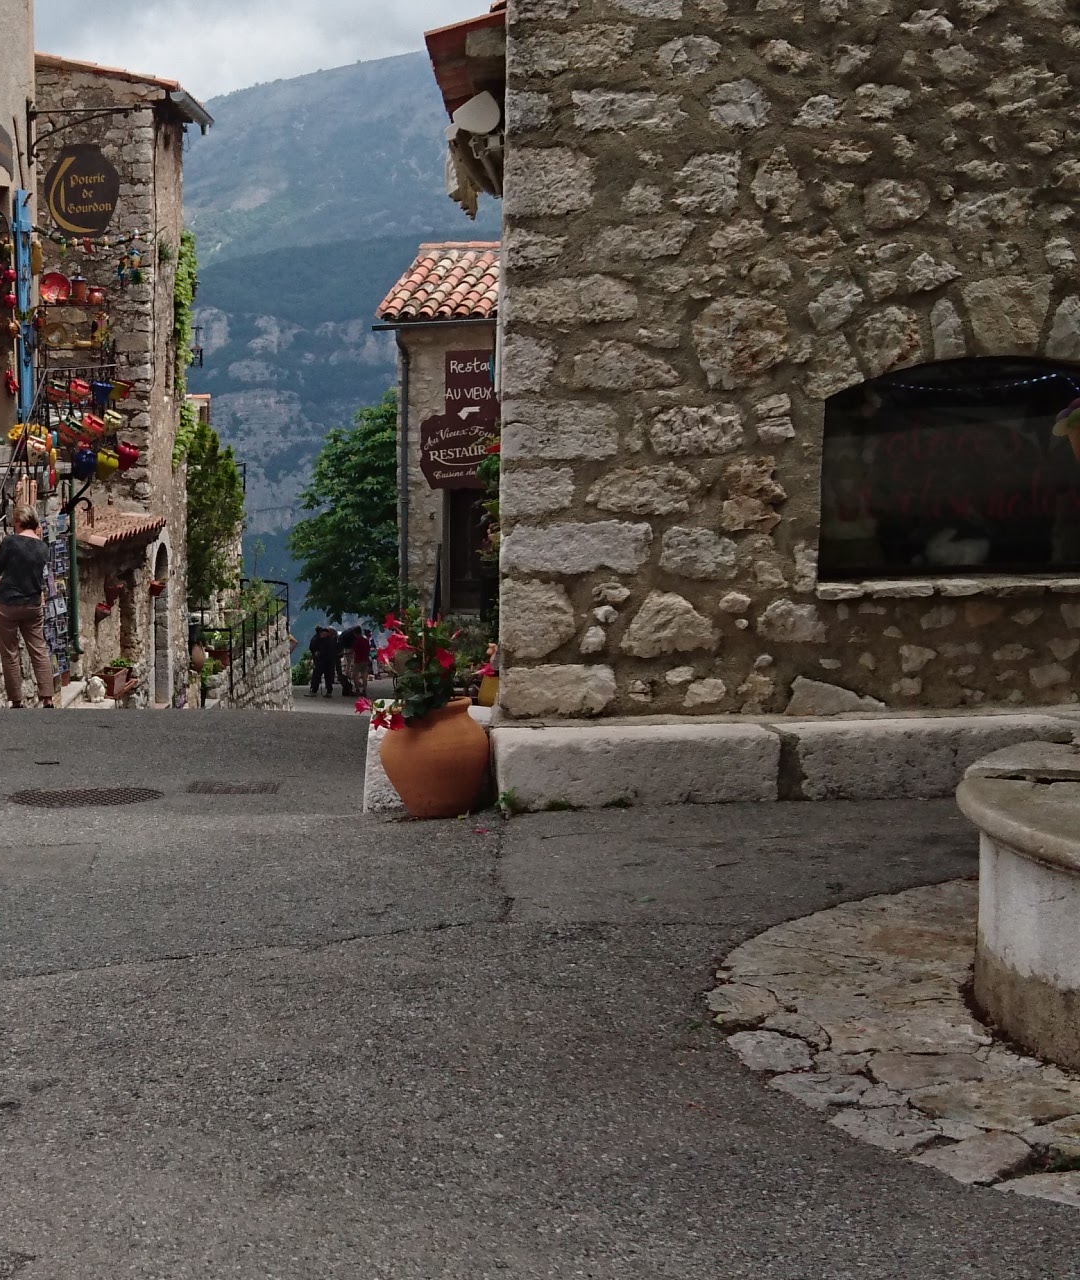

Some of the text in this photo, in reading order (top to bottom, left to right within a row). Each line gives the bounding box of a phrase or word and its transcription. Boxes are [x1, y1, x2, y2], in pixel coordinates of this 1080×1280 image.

[70, 173, 105, 188] Poterie
[82, 189, 94, 199] de
[67, 202, 112, 214] Gourdon
[445, 386, 492, 401] AU VIEUX
[423, 436, 439, 450] Au
[436, 427, 469, 440] Vieux
[433, 470, 464, 480] Cuisine
